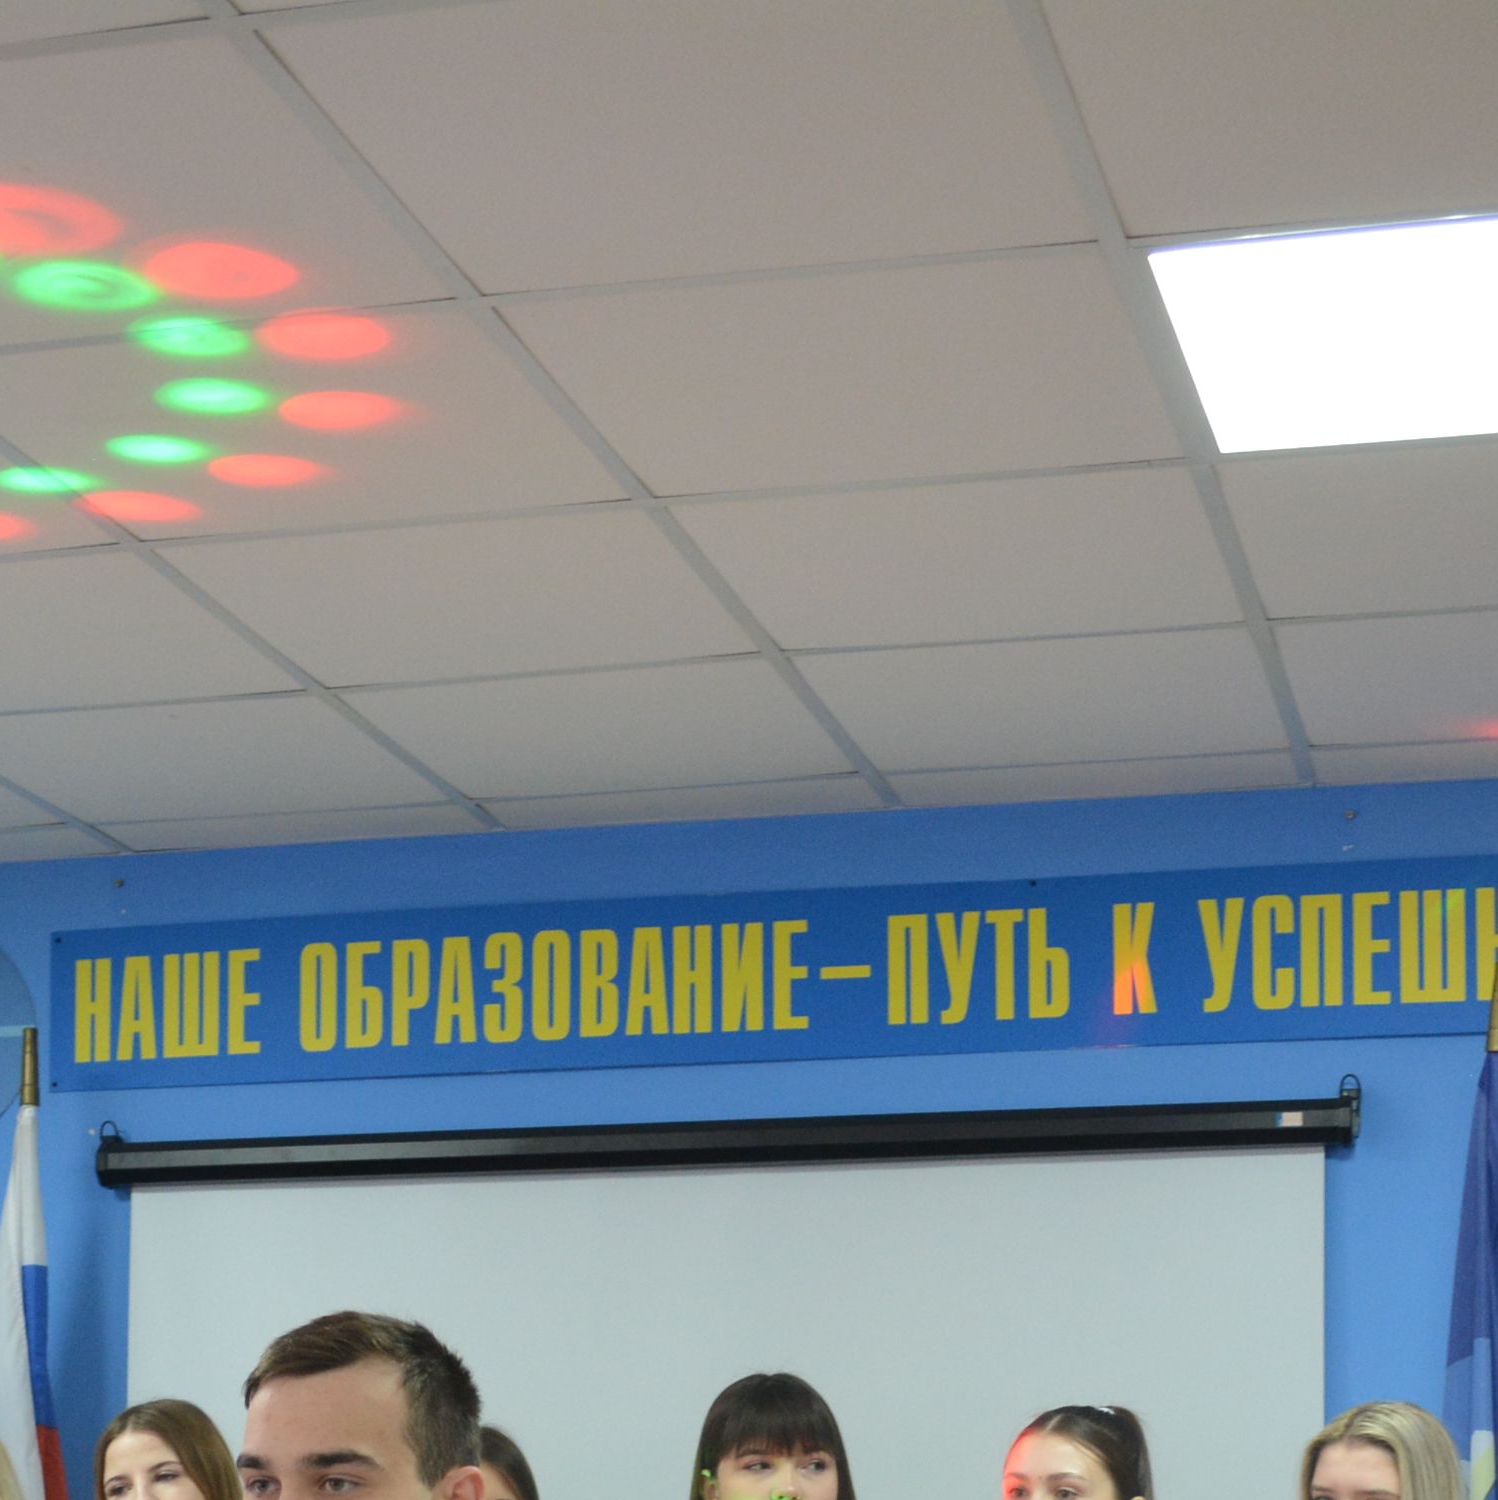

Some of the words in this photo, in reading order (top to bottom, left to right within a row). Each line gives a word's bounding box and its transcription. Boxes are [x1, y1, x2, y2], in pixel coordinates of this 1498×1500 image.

[74, 948, 263, 1064] НАШЕ
[299, 920, 810, 1053] ОБРАЗОВАНИЕ
[887, 908, 1071, 1026] ПУТЬ
[1112, 902, 1158, 1016] К
